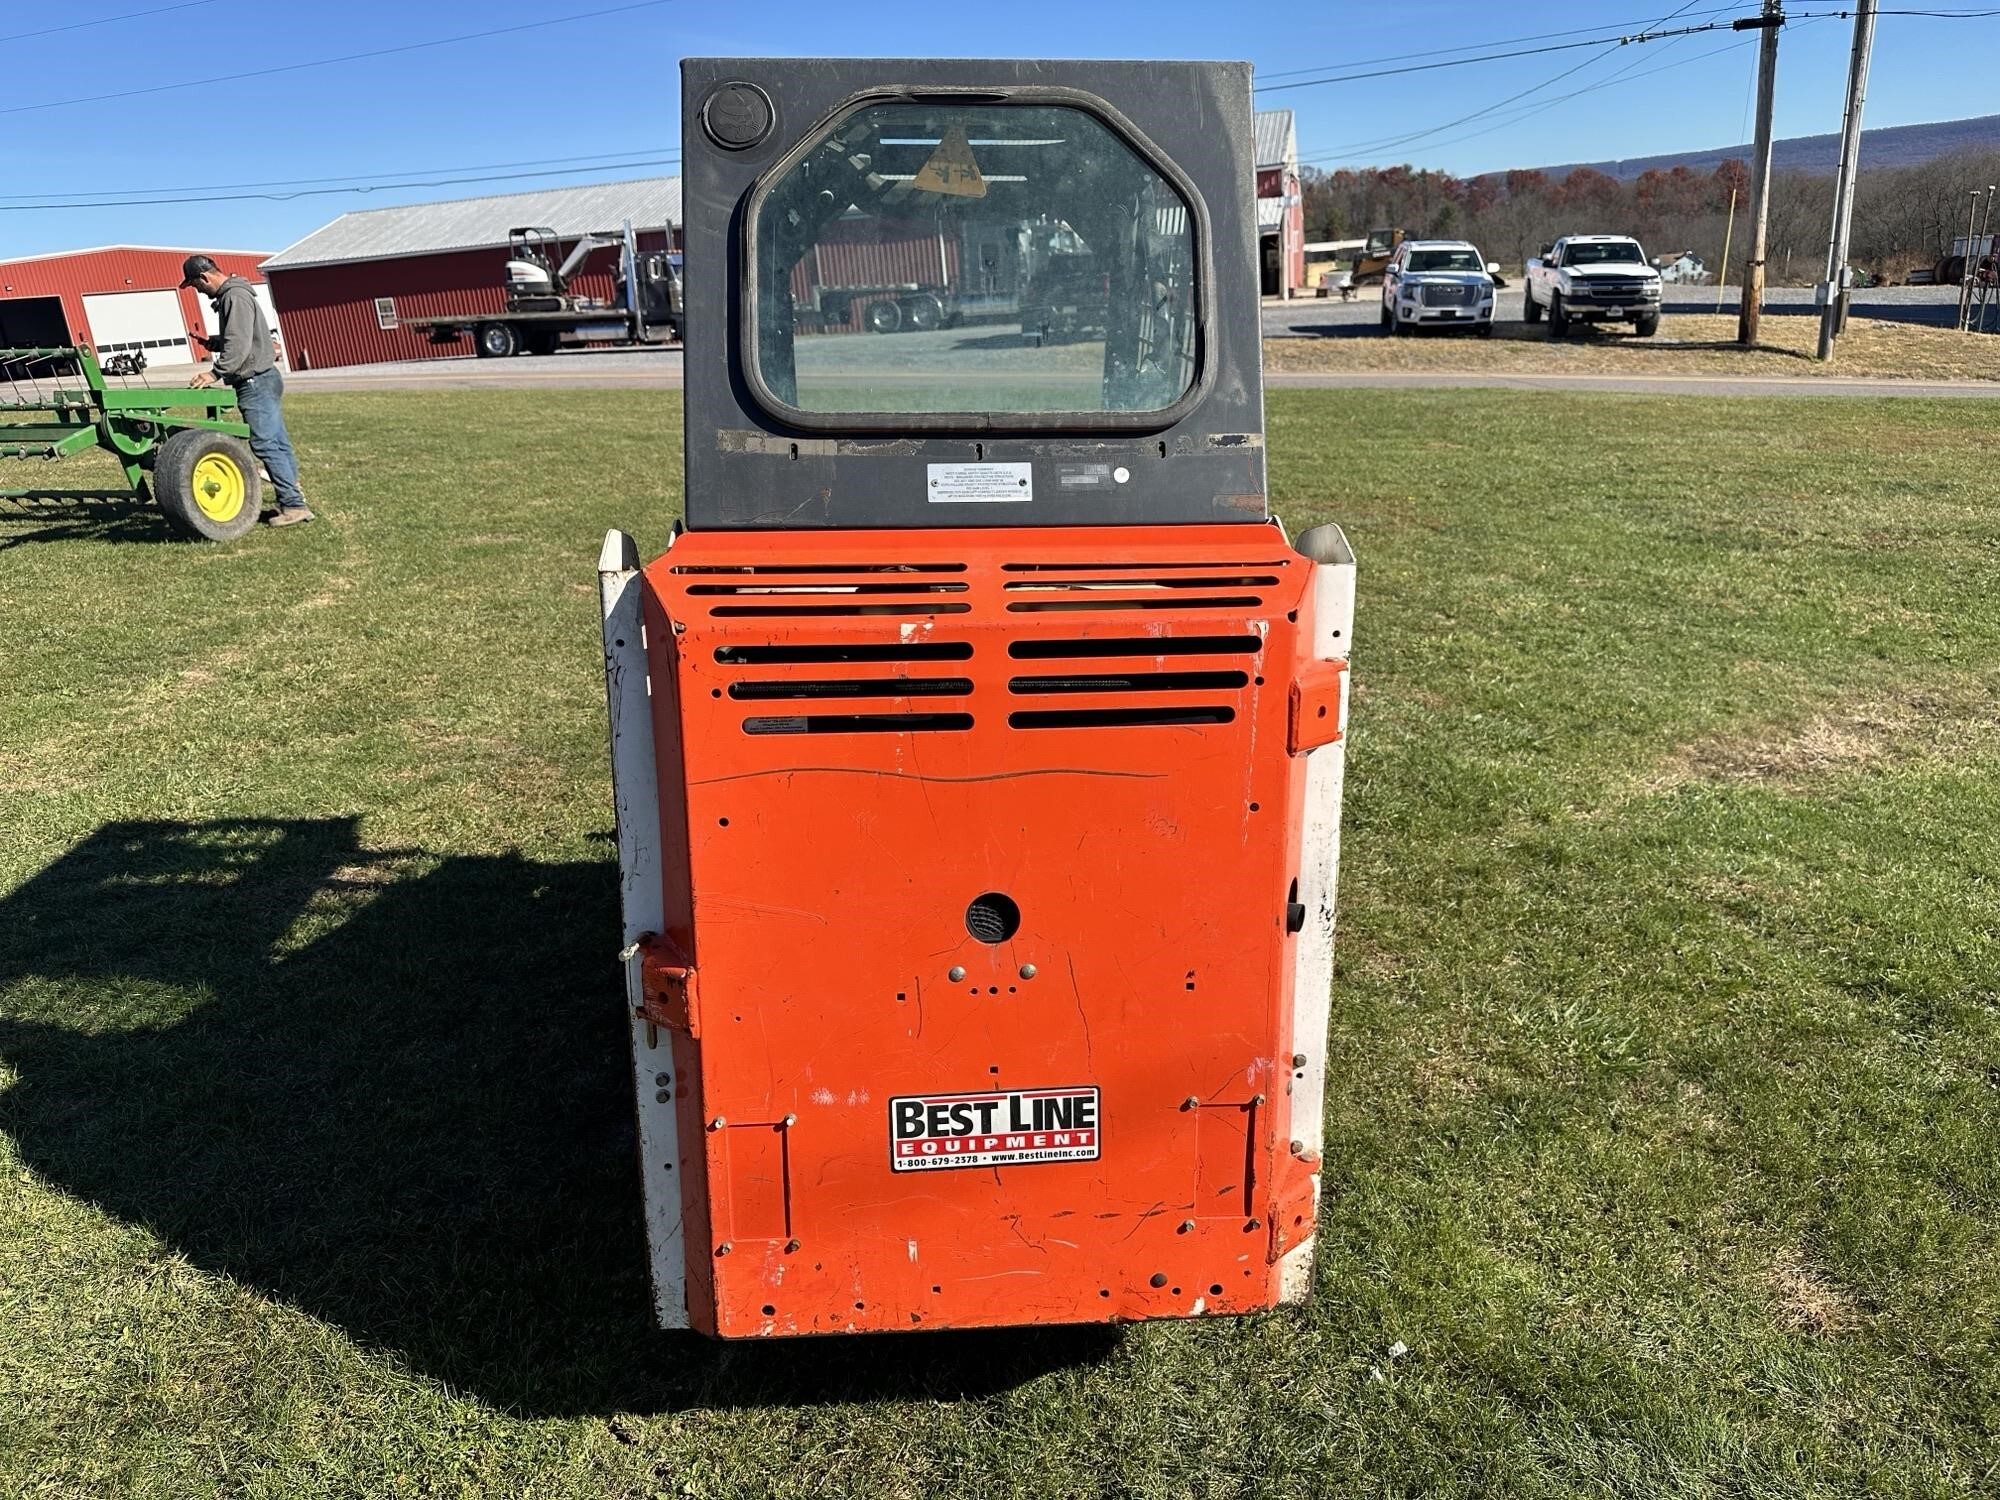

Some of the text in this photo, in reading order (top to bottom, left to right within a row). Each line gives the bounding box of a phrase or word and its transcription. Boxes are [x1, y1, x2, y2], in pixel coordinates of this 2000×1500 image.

[895, 1095, 1096, 1140] BEST LINE
[901, 1131, 1092, 1155] EQUIPMENT
[897, 1149, 1096, 1168] 1-800-679-2378 www.BestLineInc.com
